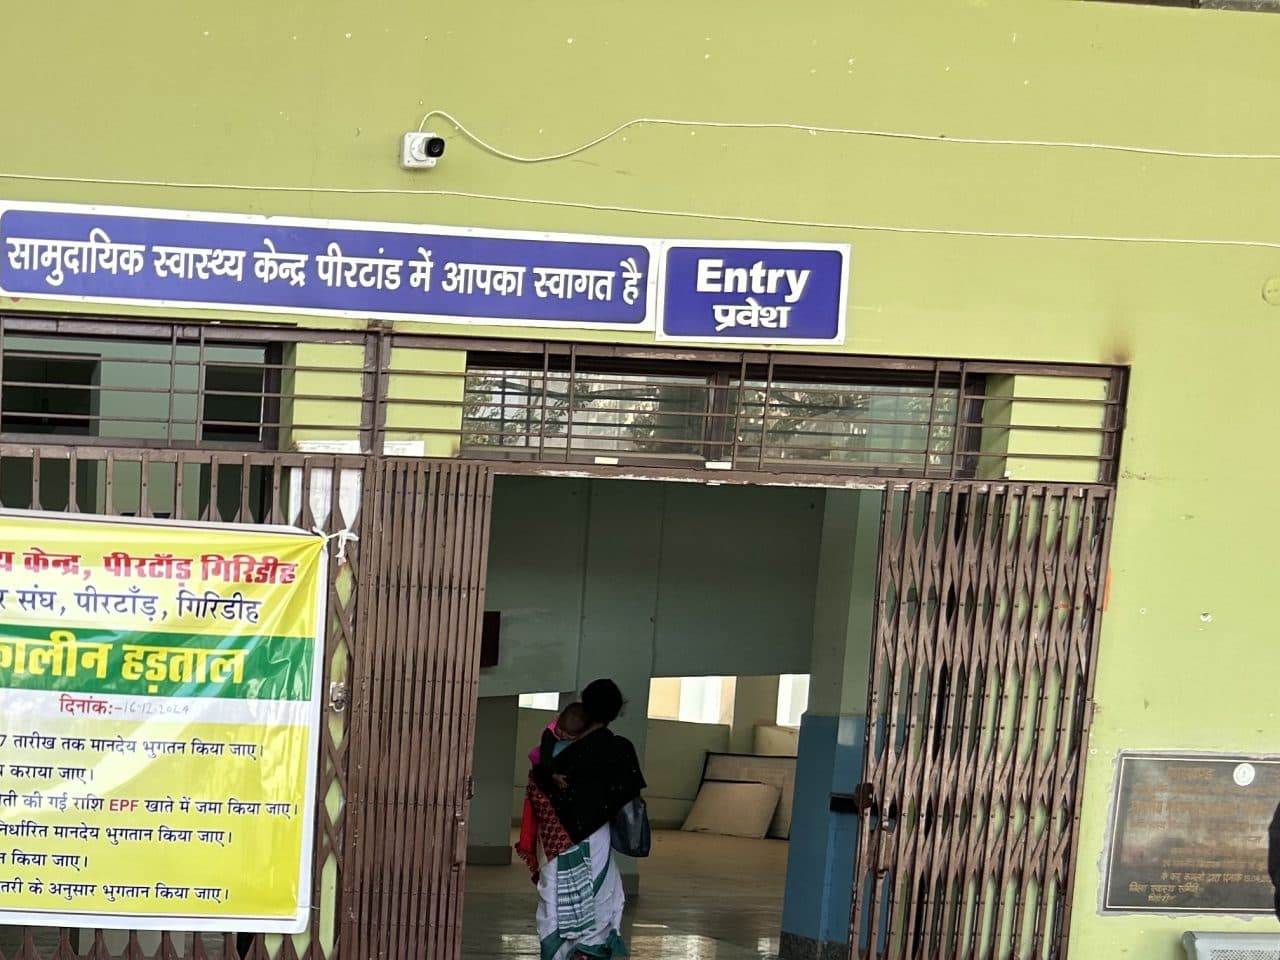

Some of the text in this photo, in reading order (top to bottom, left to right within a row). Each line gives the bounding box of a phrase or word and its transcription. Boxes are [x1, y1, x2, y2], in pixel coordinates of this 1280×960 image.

[6, 228, 145, 287] सामुदायिक
[152, 244, 246, 282] स्वास्थ्य
[253, 238, 308, 287] केन्द्र
[408, 249, 433, 293] में
[441, 262, 527, 297] आपका
[533, 266, 615, 301] स्वागत
[619, 258, 643, 306] है
[697, 258, 810, 303] Entry
[712, 298, 791, 332] प्रवेश
[22, 546, 92, 580] केन्द्र,
[200, 554, 299, 584] गिरिडीह
[176, 589, 264, 624] गिरिडीह
[122, 641, 249, 693] हड़ताल
[0, 734, 7, 747] 7
[13, 731, 56, 750] तारीख
[61, 737, 85, 751] तक
[91, 735, 136, 755] मानदेय
[191, 738, 223, 756] किया
[10, 764, 51, 779] कराया
[23, 791, 43, 809] की
[48, 792, 68, 812] गई
[73, 793, 104, 811] राशि
[109, 798, 139, 812] EPF
[145, 796, 173, 813] खाते
[180, 796, 191, 813] में
[195, 800, 222, 814] जमा
[228, 797, 260, 815] किया
[54, 822, 100, 840] मानदेय
[106, 827, 152, 845] भुगतान
[158, 825, 191, 842] किया
[11, 848, 46, 866] किया
[28, 877, 43, 895] के
[48, 883, 97, 901] अनुसार
[103, 885, 149, 902] भुगतान
[155, 883, 188, 899] किया
